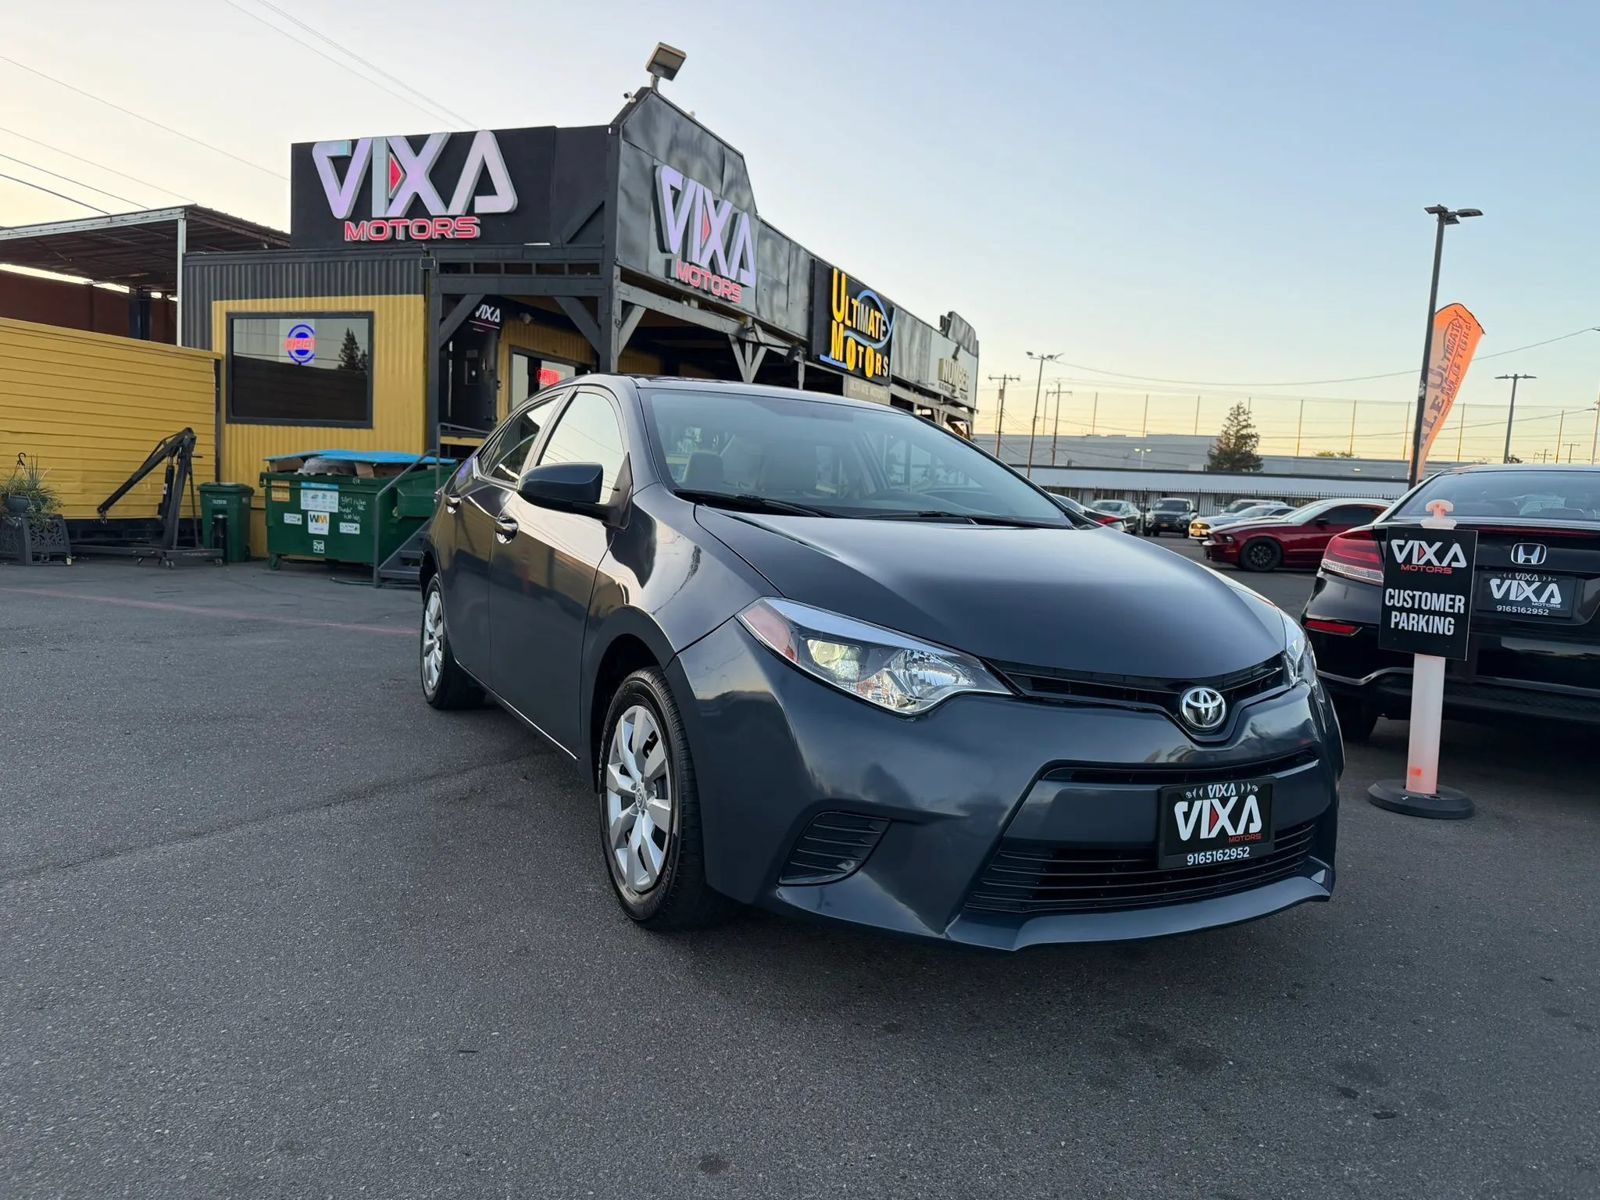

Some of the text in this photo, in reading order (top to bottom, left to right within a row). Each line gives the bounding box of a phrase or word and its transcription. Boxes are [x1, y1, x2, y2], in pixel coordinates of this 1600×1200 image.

[312, 130, 518, 219] VIXA
[344, 216, 480, 241] MOTORS
[655, 164, 757, 288] VIXA
[676, 259, 742, 304] MOTORS
[832, 267, 887, 341] ULTIMATE
[831, 320, 889, 377] MOTORS
[309, 514, 328, 524] WM
[1390, 539, 1467, 568] VIXA
[1400, 565, 1453, 575] MOTORS
[1515, 573, 1539, 581] VIXA
[1385, 588, 1465, 614] CUSTOMER
[1489, 578, 1562, 604] VIXA
[1496, 605, 1549, 616] 9165162952
[1390, 611, 1455, 636] PARKING
[1207, 783, 1236, 798] VIXA
[1174, 795, 1263, 841] VIXA
[1228, 833, 1263, 844] MOTORS
[1187, 847, 1250, 866] 9165162952
